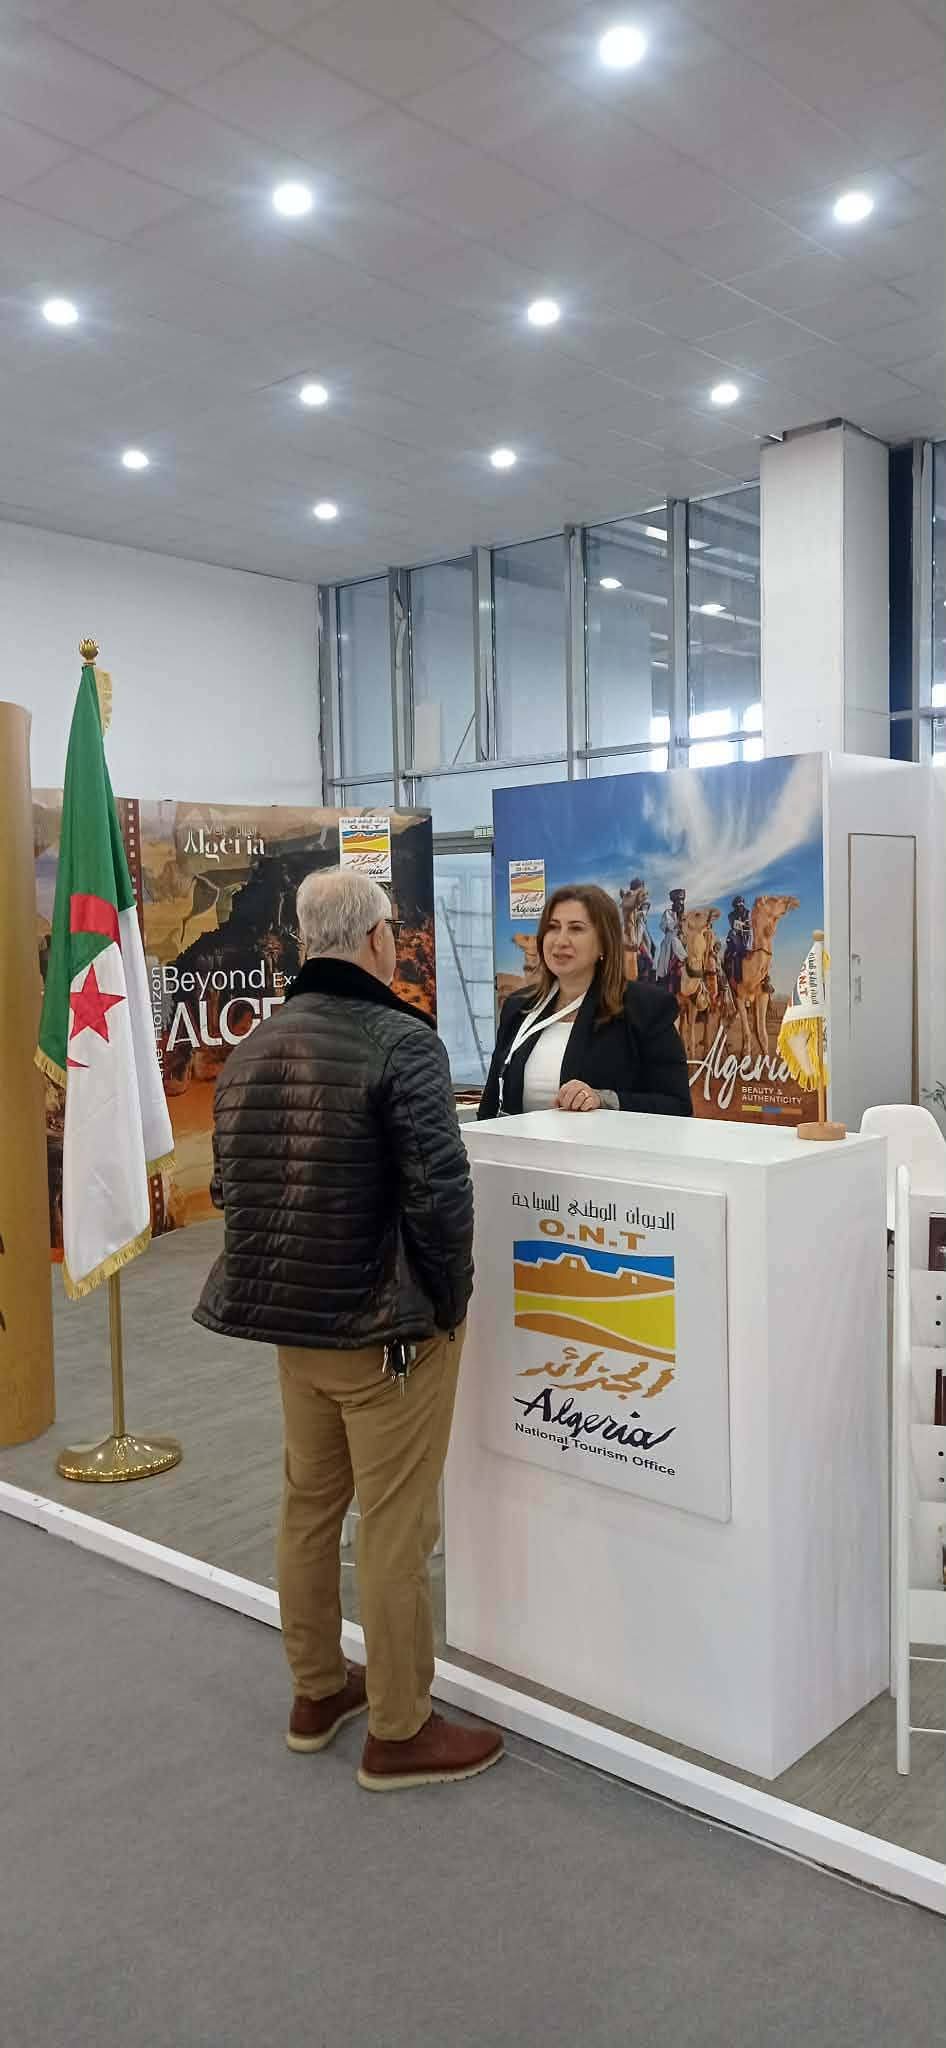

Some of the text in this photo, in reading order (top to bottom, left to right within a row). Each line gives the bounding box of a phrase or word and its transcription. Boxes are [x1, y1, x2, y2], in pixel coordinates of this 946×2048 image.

[183, 826, 265, 863] Algeria
[162, 959, 297, 1000] Beyond Ex
[151, 966, 163, 1041] Horizon
[687, 1023, 790, 1109] Algeria
[741, 1086, 775, 1095] BEAUTY
[741, 1093, 802, 1105] AUTHENTICITY
[512, 1191, 560, 1213] للسياحة
[625, 1206, 674, 1231] الديوان
[538, 1218, 646, 1250] O.N.T
[515, 1346, 675, 1399] الجزائر
[513, 1385, 677, 1450] Algeria
[514, 1422, 676, 1477] National Tourism Office
